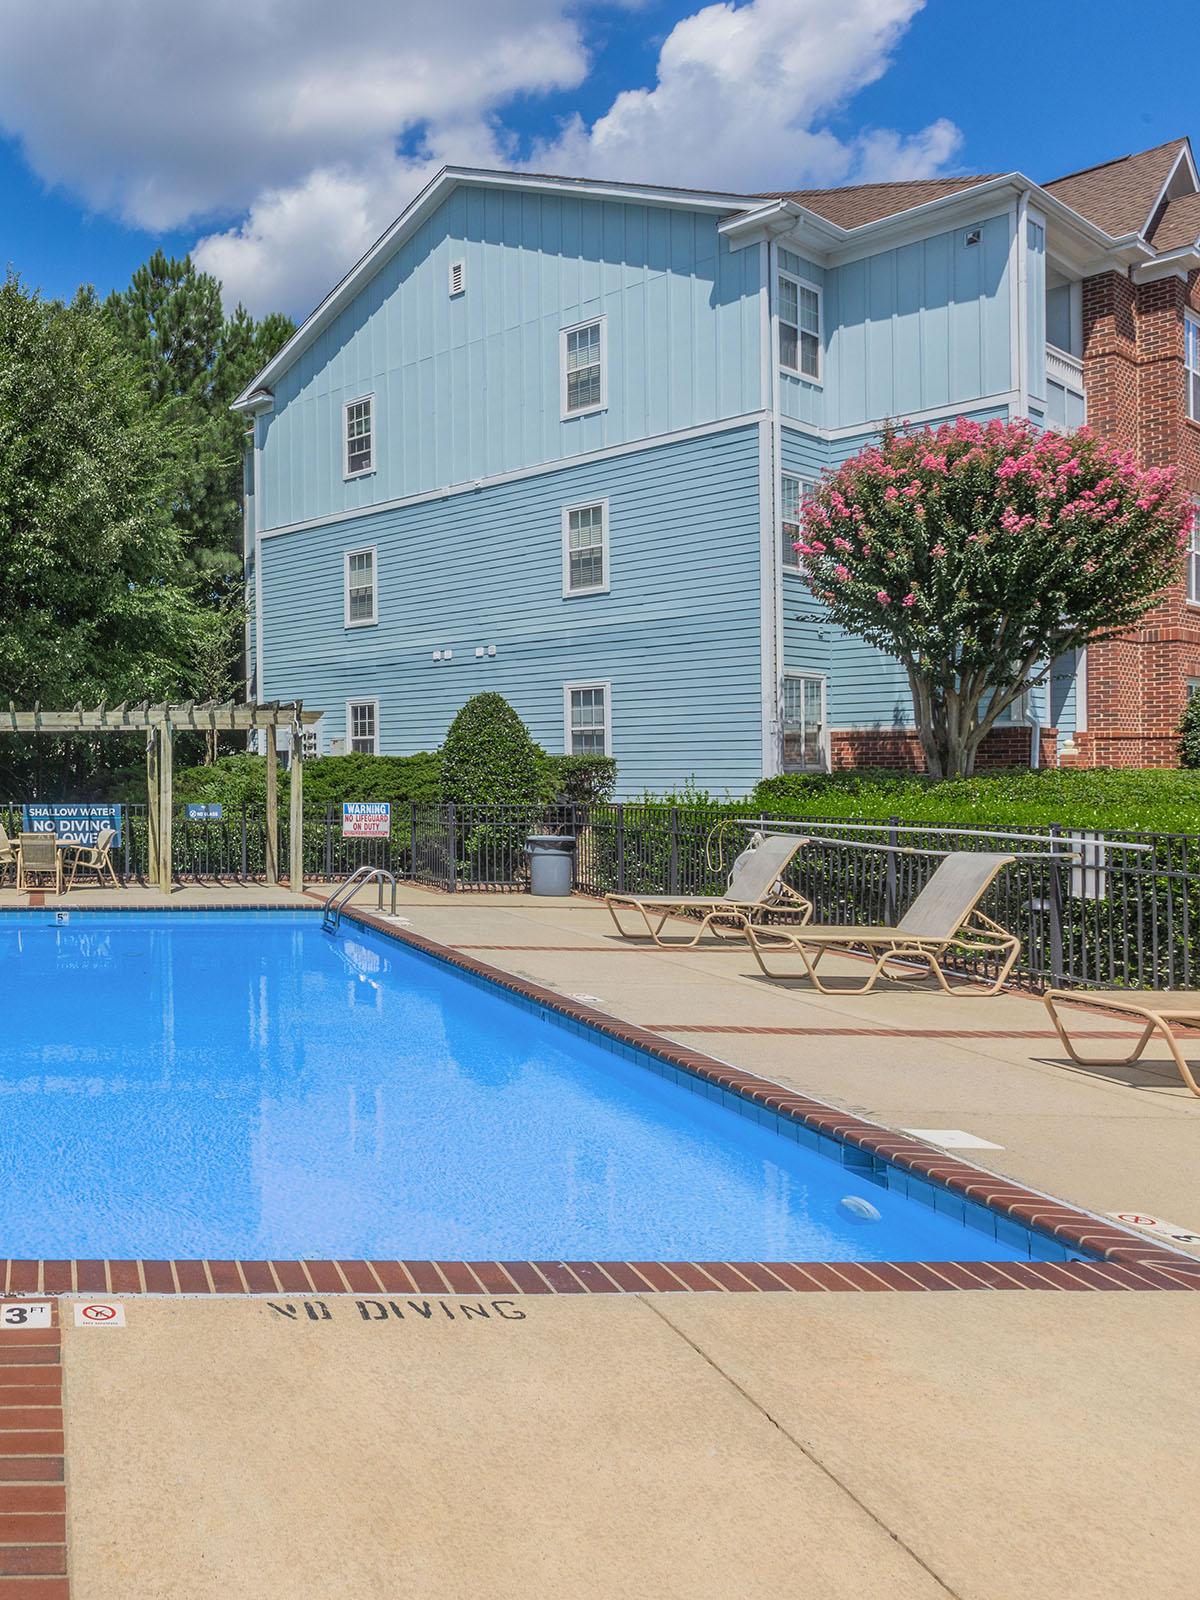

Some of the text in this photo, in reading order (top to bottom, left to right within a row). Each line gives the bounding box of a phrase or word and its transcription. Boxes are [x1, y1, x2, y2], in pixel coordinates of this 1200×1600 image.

[29, 808, 116, 817] SHALLOW WATER
[347, 804, 387, 814] WARNING
[344, 814, 389, 822] NO LIFEGUARD
[33, 820, 112, 832] NO DIVING
[352, 822, 380, 831] ON DUTY
[5, 1307, 29, 1324] 3
[355, 1301, 526, 1320] DIVING
